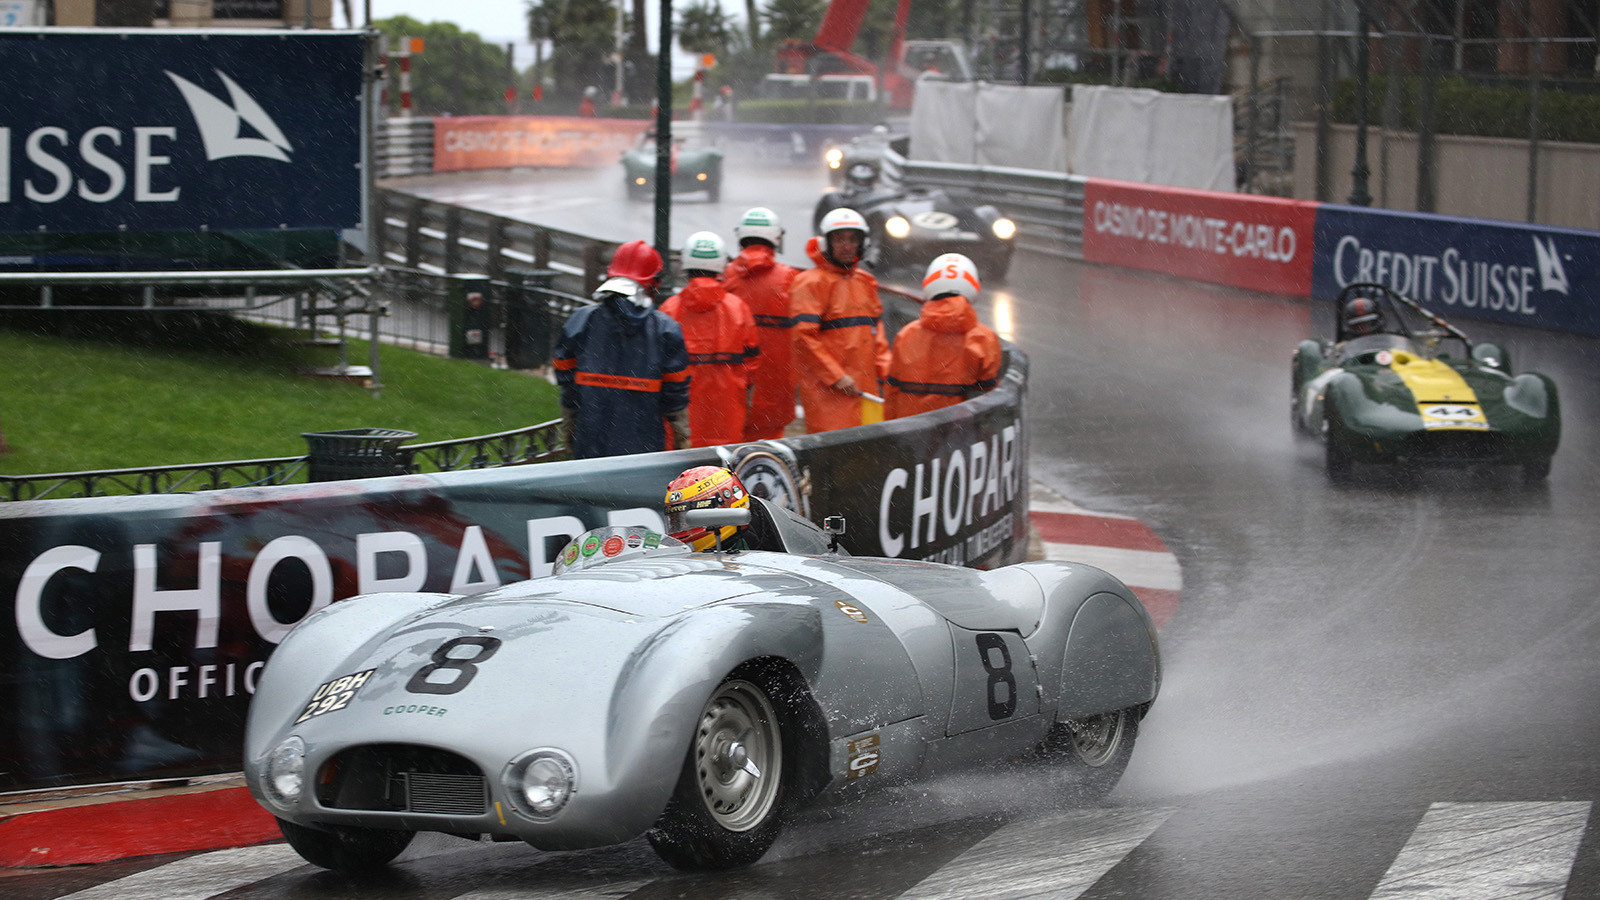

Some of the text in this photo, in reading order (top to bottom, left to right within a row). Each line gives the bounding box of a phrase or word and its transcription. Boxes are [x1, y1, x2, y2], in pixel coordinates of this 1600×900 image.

[1093, 200, 1297, 263] CASINO DE MONTE-CARLO
[945, 264, 959, 280] S
[1441, 247, 1537, 315] SUISSE
[312, 669, 374, 702] UBH
[405, 636, 503, 695] 8
[975, 632, 1017, 721] 8
[294, 690, 355, 725] 292
[383, 703, 448, 718] COOPER
